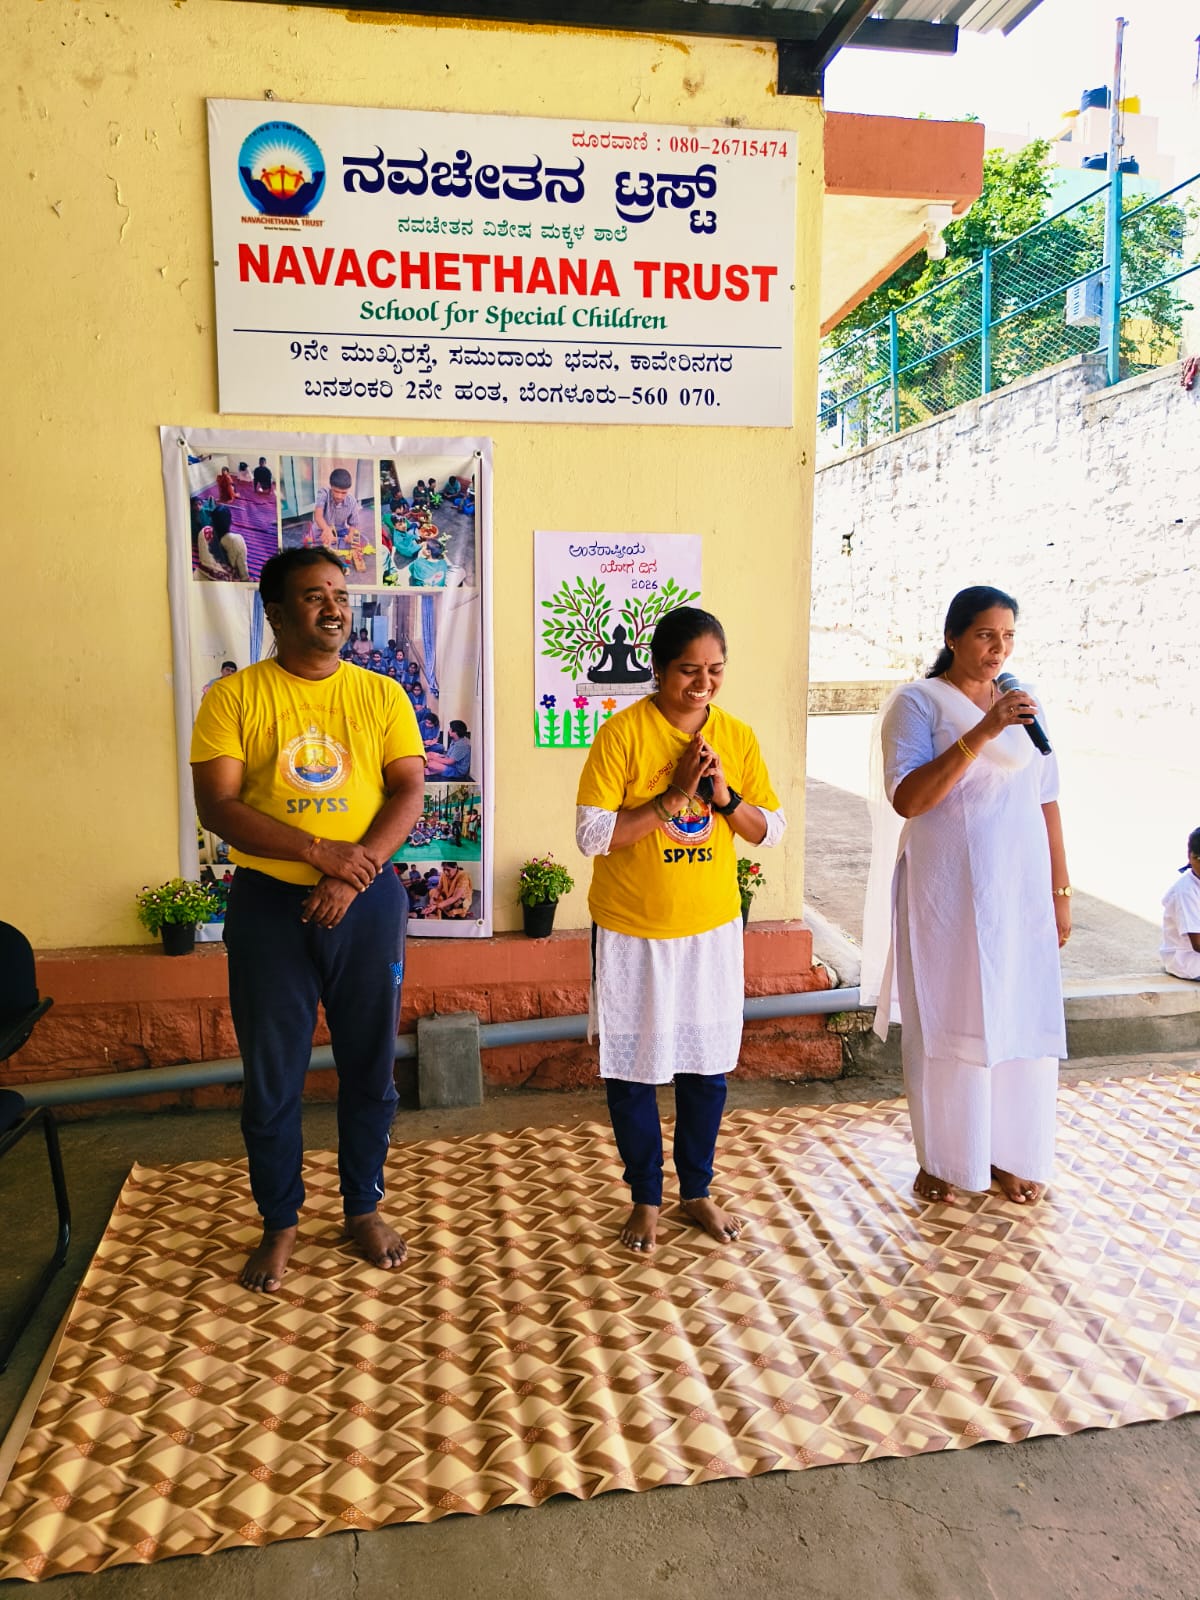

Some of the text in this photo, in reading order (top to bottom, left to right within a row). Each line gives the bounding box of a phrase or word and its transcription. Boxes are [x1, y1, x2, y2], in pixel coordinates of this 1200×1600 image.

[573, 132, 647, 150] ದೂರವಾಣಿ
[343, 145, 716, 234] ನವಚೇತನ ಟ್ರಸ್ಟ್
[241, 215, 324, 227] NAVACHETHANA TRUST
[398, 217, 627, 249] ನವಚೇತನ ವಿಶೇಷ ಮಕ್ಕಳ ಶಾಲೆ
[239, 243, 777, 302] NAVACHETHANA TRUST
[360, 299, 667, 332] School for Special Children
[291, 340, 732, 374] 9ನೇ ಮುಖ್ಯರಸ್ತೆ, ಸಮುದಾಯ ಭವನ, ಕಾವೇರಿನಗರ
[305, 377, 393, 398] ಬನಶಂಕರಿ
[406, 379, 441, 399] 2ನೇ
[455, 382, 507, 403] ಹಂತ,
[680, 389, 720, 406] 070.
[601, 560, 657, 573] ಯೋಗ ದಿನ
[632, 580, 657, 589] 2026
[286, 798, 349, 814] SPYSS
[664, 848, 712, 864] SPYSS
